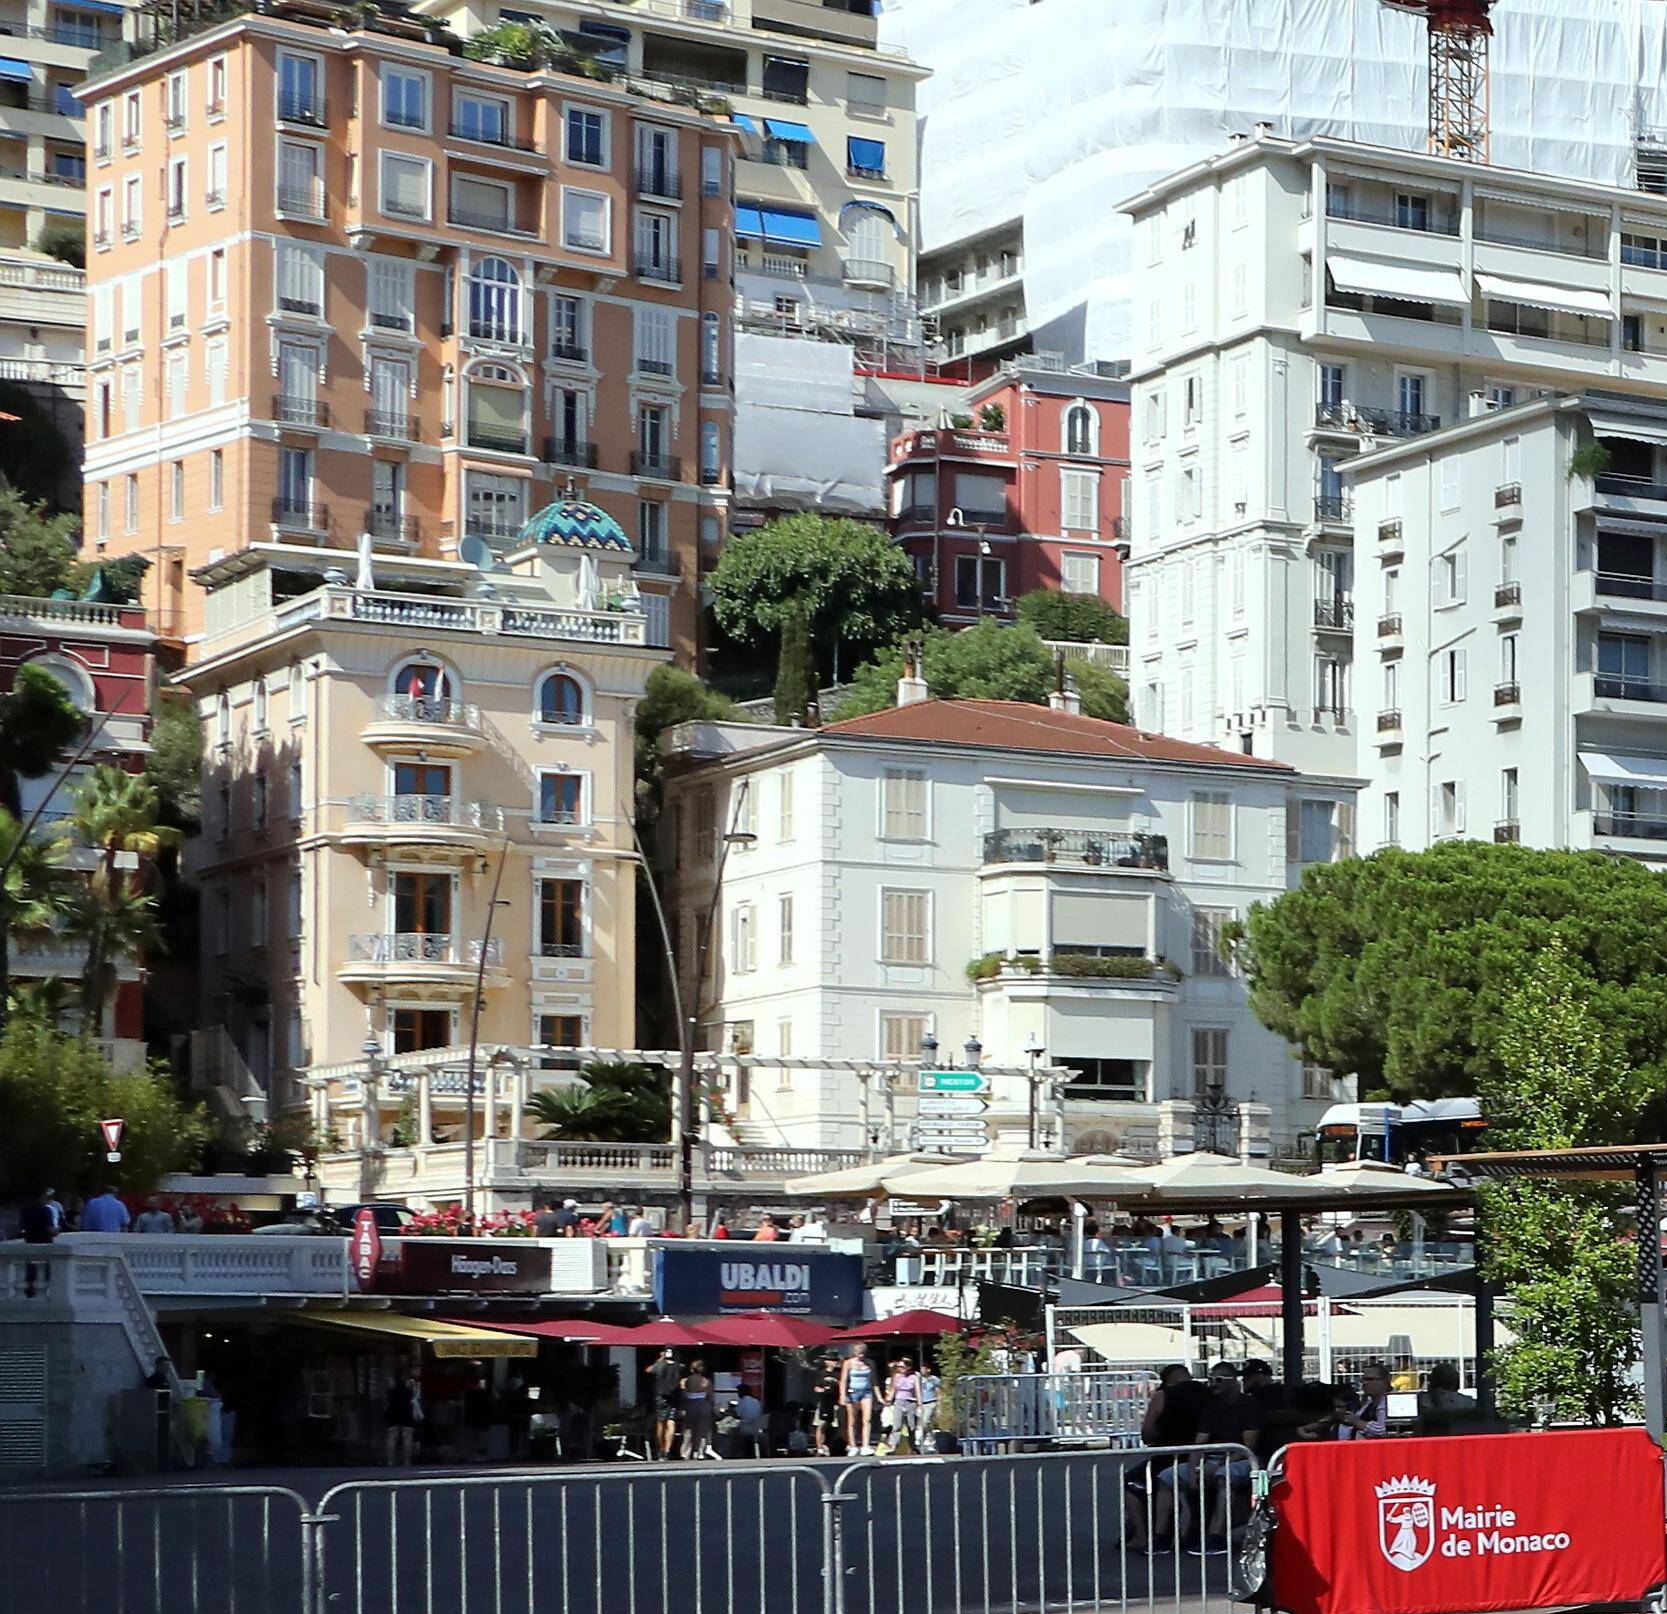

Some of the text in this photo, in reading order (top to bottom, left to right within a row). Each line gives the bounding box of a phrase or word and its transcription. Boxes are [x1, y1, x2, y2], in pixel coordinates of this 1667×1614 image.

[358, 1220, 374, 1280] TABAC
[720, 1262, 811, 1291] UBALDI
[1440, 1503, 1517, 1531] Mairie
[1440, 1531, 1571, 1557] de Monaco
